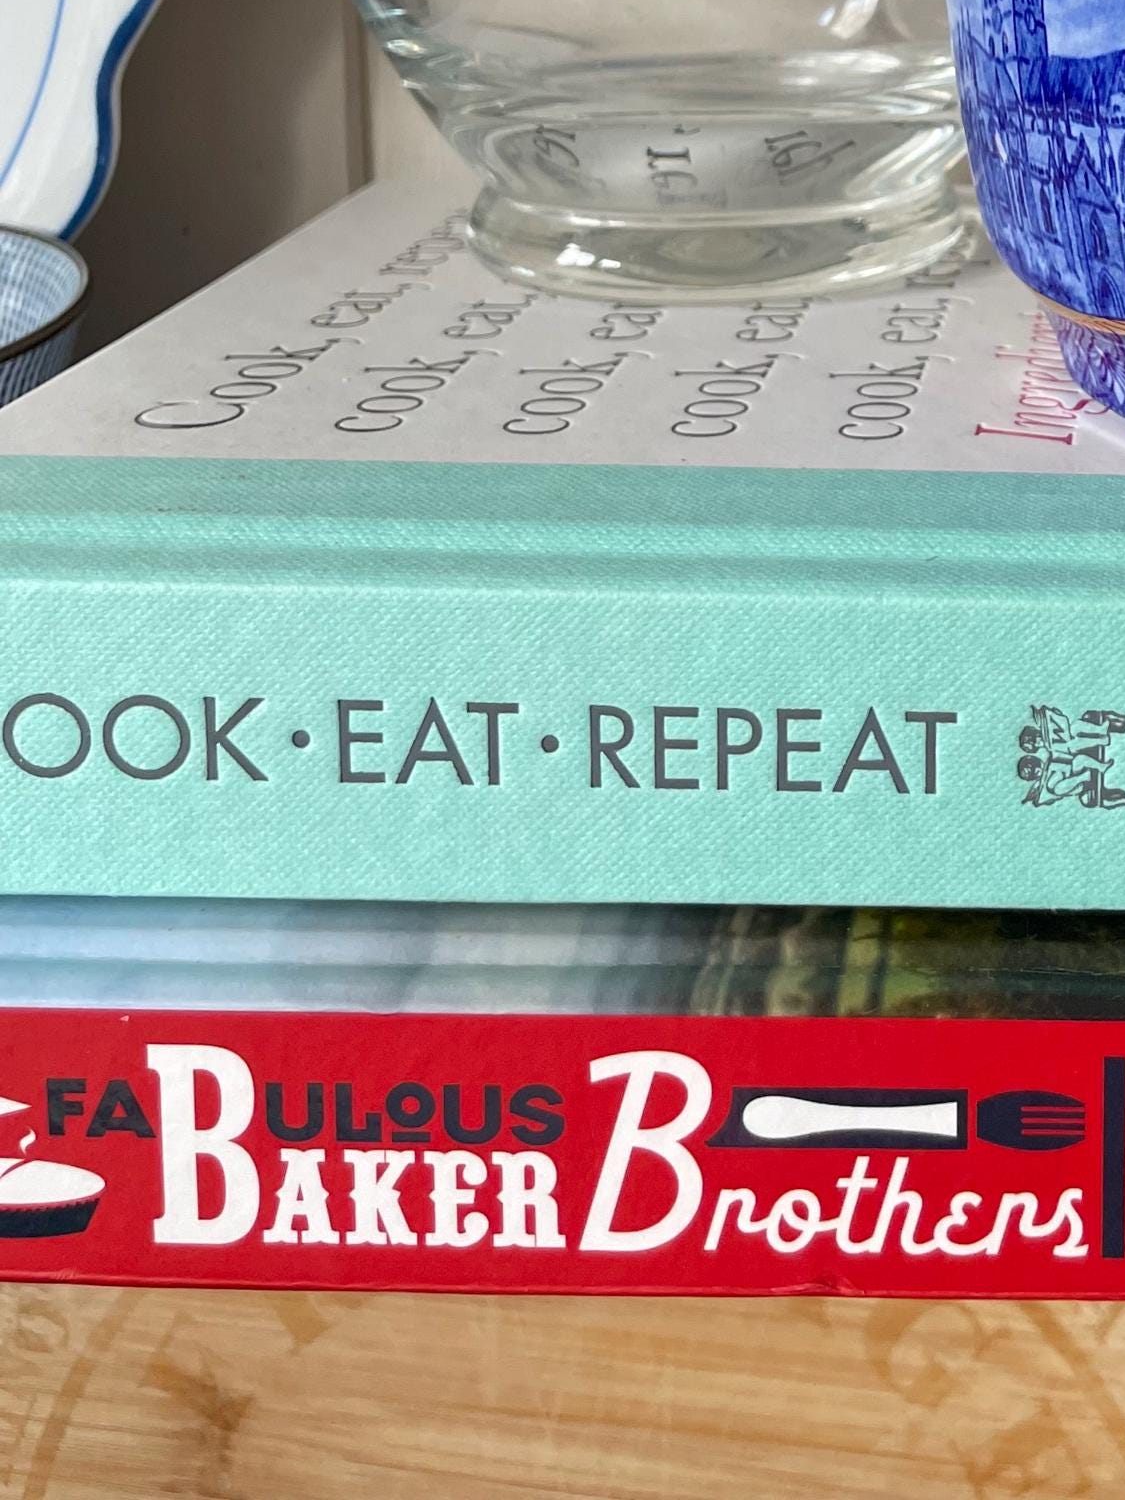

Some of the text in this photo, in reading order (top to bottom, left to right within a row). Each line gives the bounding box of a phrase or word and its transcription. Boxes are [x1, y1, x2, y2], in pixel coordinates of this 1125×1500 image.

[134, 337, 364, 429] Cook,
[310, 282, 432, 329] eat,
[880, 297, 974, 343] eat,
[334, 349, 503, 433] cook,
[502, 351, 653, 435] cook,
[671, 353, 805, 437] cook,
[828, 355, 955, 440] cook,
[336, 697, 519, 786] EAT
[588, 704, 958, 795] REPEAT
[146, 1043, 1090, 1258] BAKER Brothers
